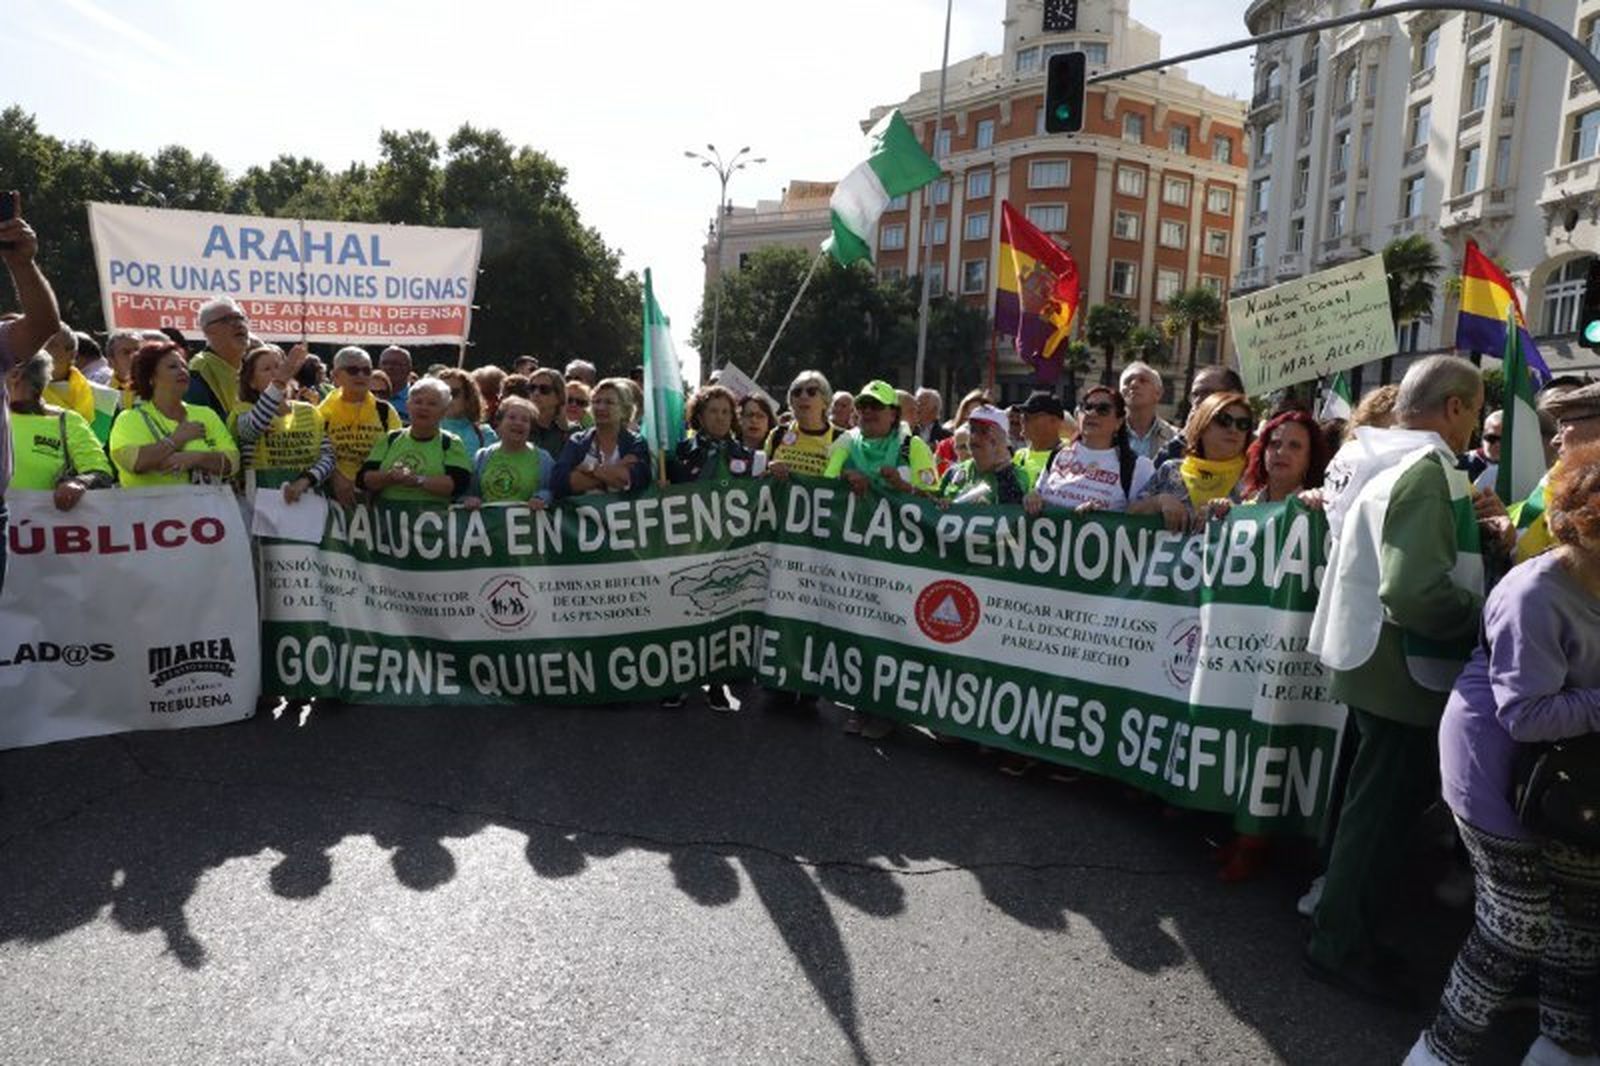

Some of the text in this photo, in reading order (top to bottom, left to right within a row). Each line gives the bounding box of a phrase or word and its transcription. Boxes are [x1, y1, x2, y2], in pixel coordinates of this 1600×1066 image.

[201, 223, 391, 267] ARAHAL
[110, 259, 469, 301] POR UNAS PENSIONES DIGNAS
[116, 294, 464, 320] PLATAFOA DE ARAHAL EN DEFENSA
[160, 314, 188, 329] DE
[249, 319, 429, 335] ENSIONES PÚBLICAS
[9, 516, 226, 555] ÚBLICO
[505, 500, 563, 557] EN
[576, 484, 778, 554] DEFENSA
[785, 484, 834, 539] DE
[842, 491, 925, 555] LAS
[935, 513, 1203, 592] PENSIONES
[538, 575, 661, 593] ELIMINAR BRECHA
[798, 578, 816, 589] SIN
[840, 571, 914, 594] ANTICIPADA
[553, 596, 569, 607] DE
[630, 591, 648, 603] EN
[768, 589, 796, 602] CON
[836, 602, 908, 626] COTIZADOS
[986, 595, 1052, 617] DEROGAR
[551, 606, 651, 622] LAS PENSIONES
[983, 613, 1003, 627] NO
[1017, 619, 1035, 633] LA
[148, 636, 236, 675] MAREA
[1001, 633, 1130, 669] PAREJAS DE HECHO
[1206, 656, 1223, 672] 65
[149, 692, 233, 713] TREBUJENA
[469, 651, 595, 697] QUIEN
[801, 635, 863, 697] LAS
[873, 654, 1107, 758] PENSIONES
[1117, 707, 1169, 776] SE
